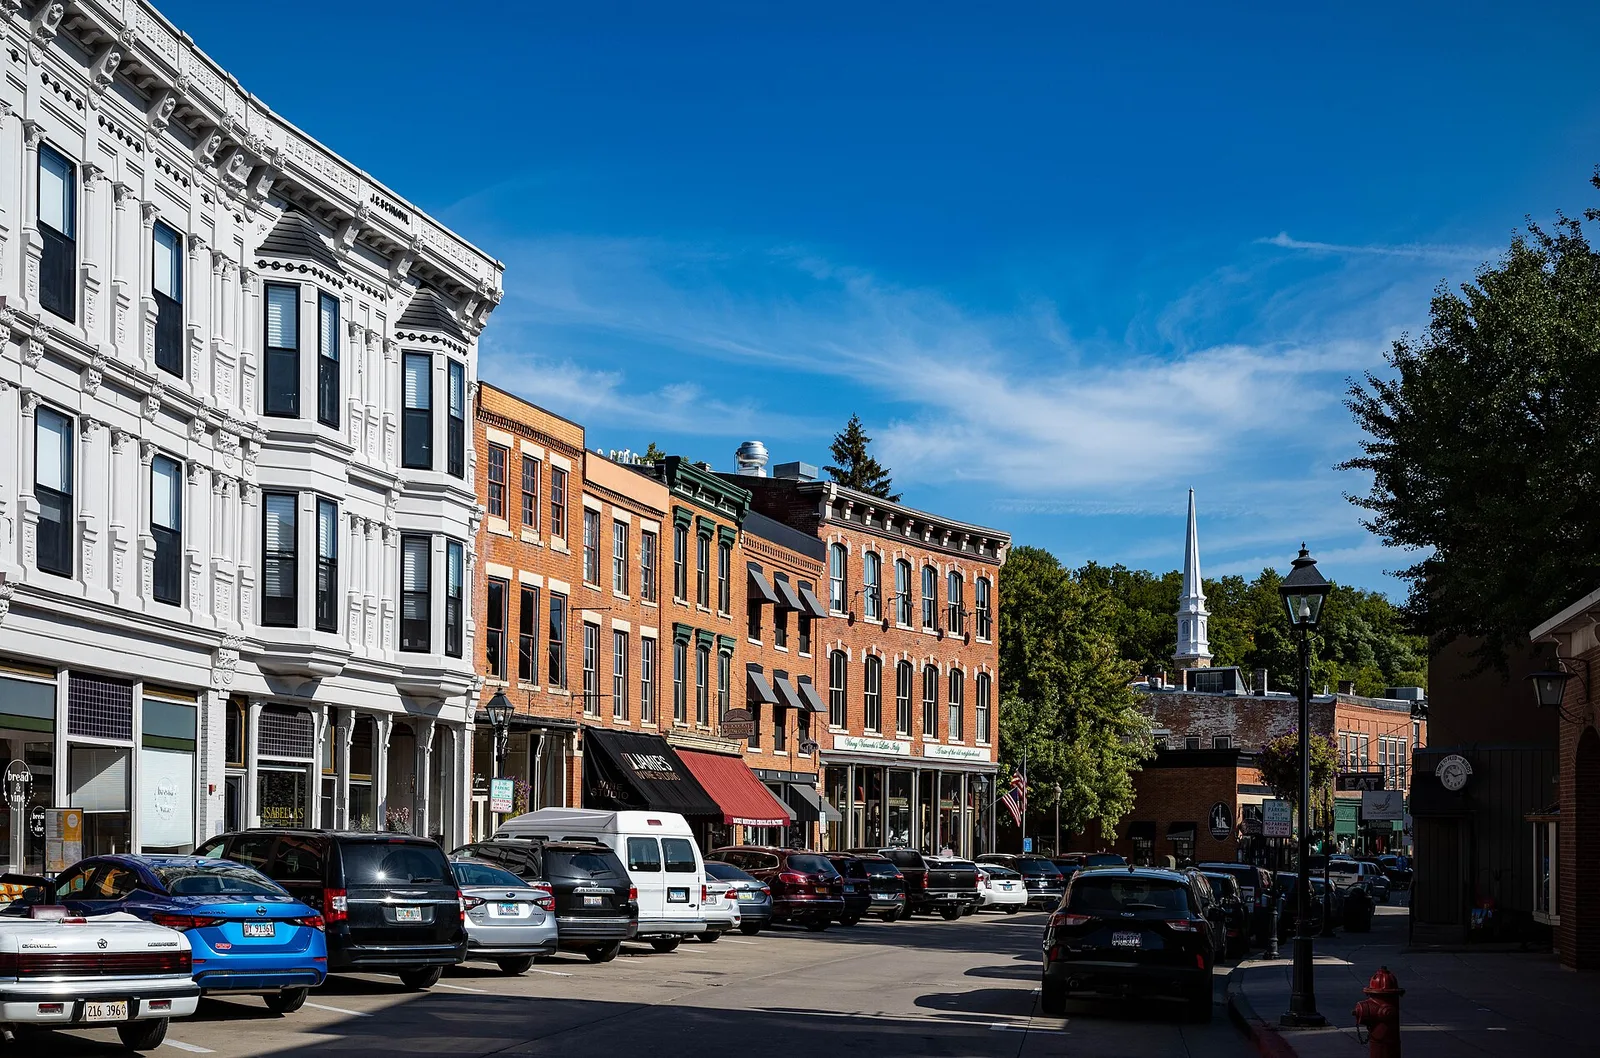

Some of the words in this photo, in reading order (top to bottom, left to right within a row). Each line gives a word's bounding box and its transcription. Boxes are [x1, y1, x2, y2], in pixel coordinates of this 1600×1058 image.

[631, 753, 672, 771] JAMIE'S
[7, 770, 29, 782] bread
[598, 780, 623, 791] WINE
[1344, 777, 1379, 791] EAT
[590, 788, 630, 800] STUDIO
[32, 812, 45, 820] brea
[263, 806, 304, 819] ISABELLA'S
[254, 924, 274, 933] 91361
[88, 1005, 102, 1017] 216
[106, 1004, 121, 1016] 396
